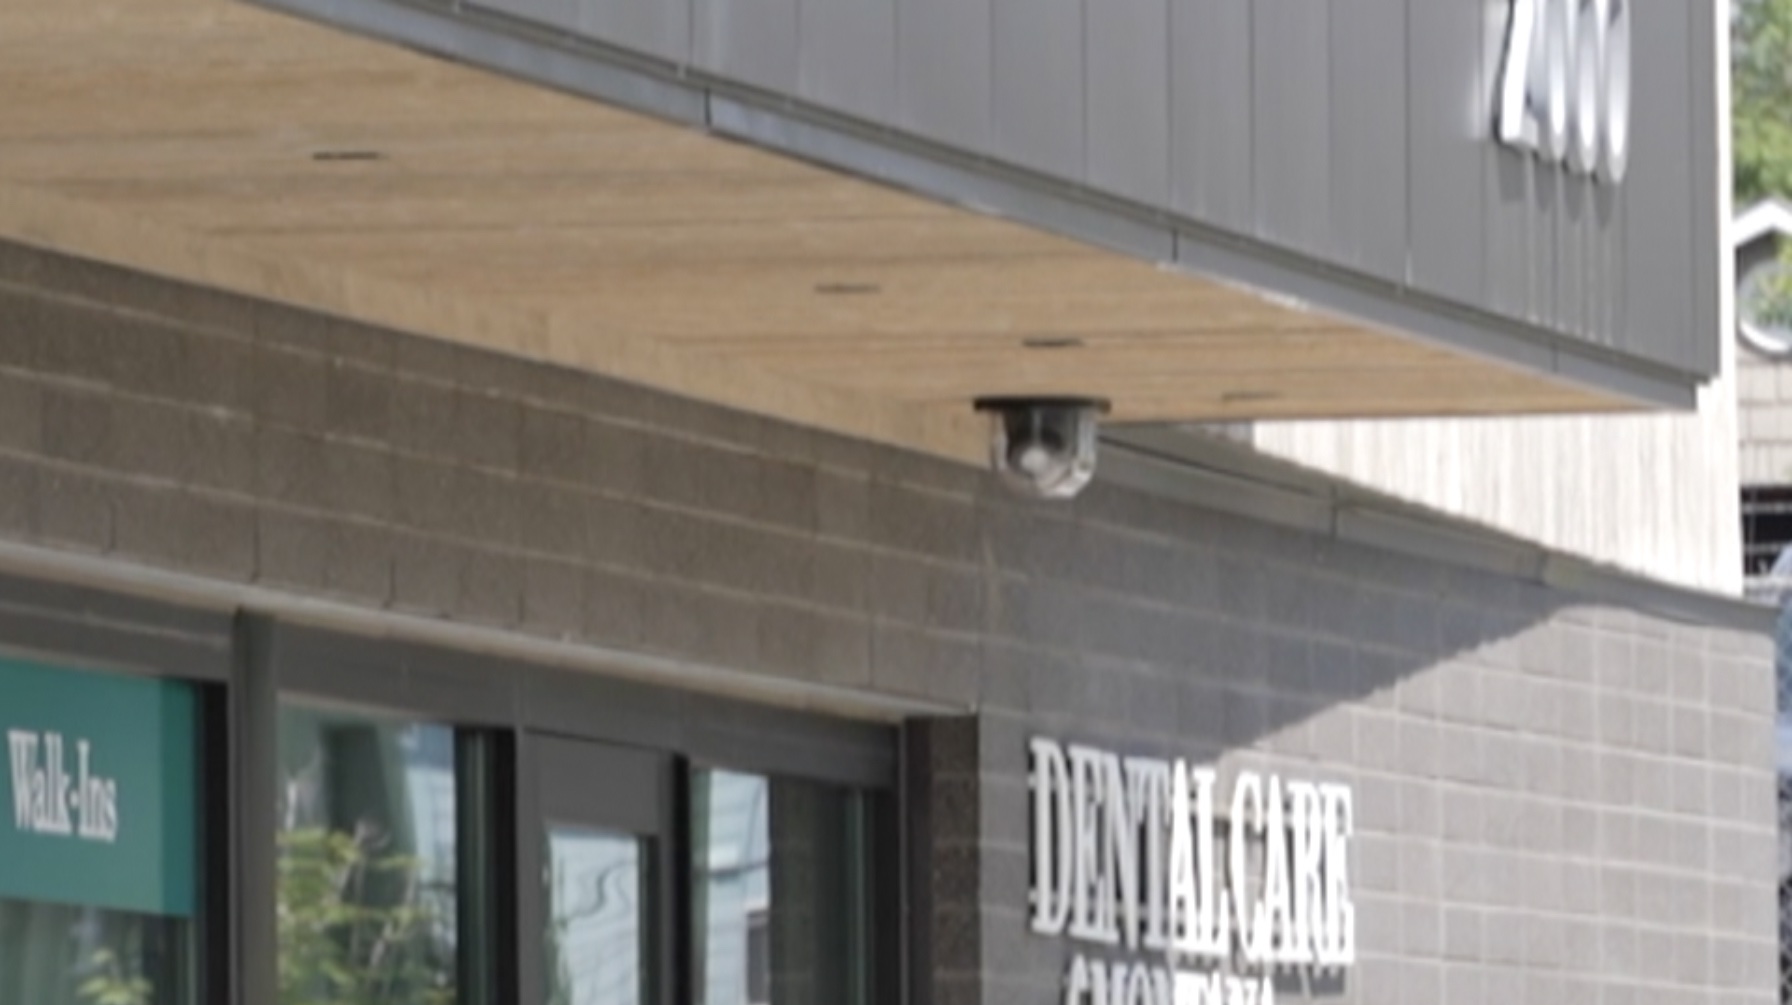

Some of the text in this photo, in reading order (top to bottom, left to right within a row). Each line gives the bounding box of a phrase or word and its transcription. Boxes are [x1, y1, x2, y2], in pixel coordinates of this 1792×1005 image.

[7, 729, 117, 842] Walk-Ins
[1030, 738, 1355, 965] DENTAL CARE
